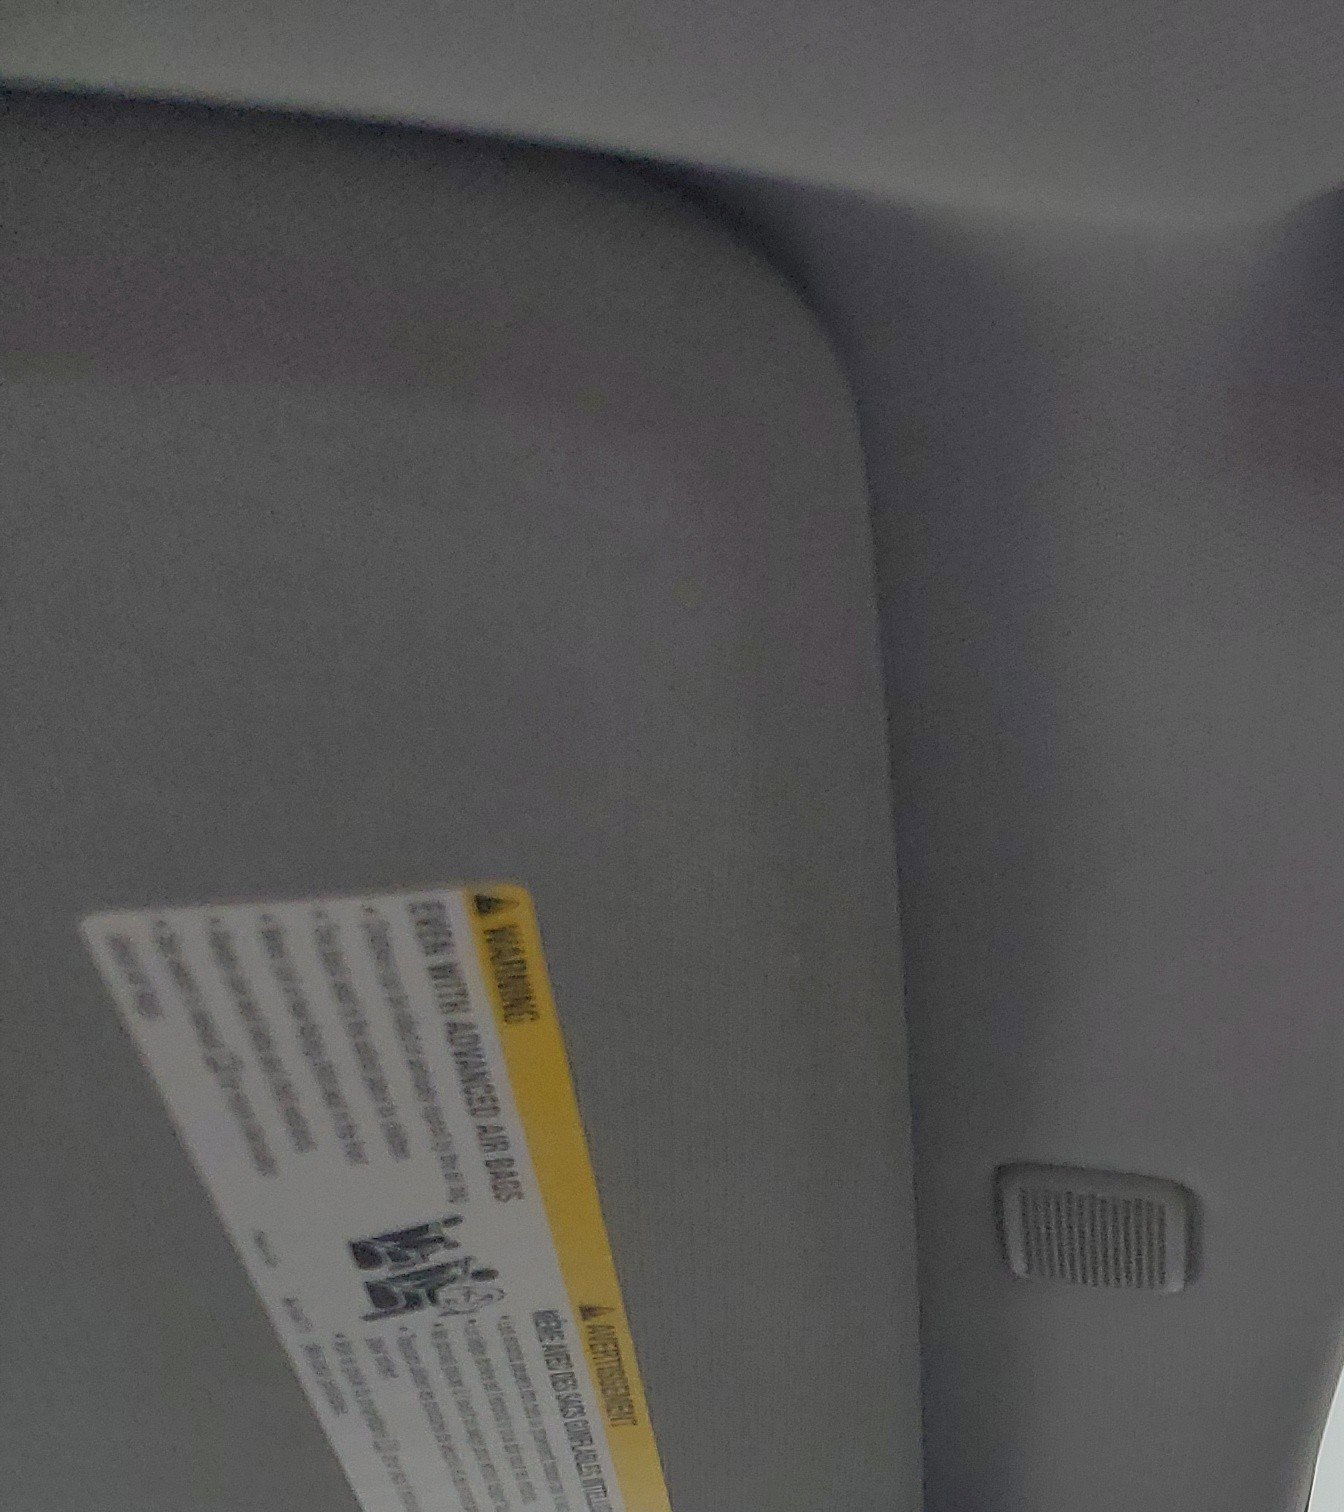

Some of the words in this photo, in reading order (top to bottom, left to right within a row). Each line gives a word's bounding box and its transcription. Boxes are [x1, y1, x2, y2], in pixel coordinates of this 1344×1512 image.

[408, 899, 455, 956] EVEN
[427, 961, 472, 1014] WITH
[483, 922, 540, 1025] WARNING
[445, 1019, 501, 1118] ADVANCED
[476, 1122, 511, 1154] AIR
[485, 1156, 525, 1203] BAGS
[550, 1371, 579, 1394] DES
[586, 1322, 638, 1428] AVERTISSEMENT
[556, 1392, 586, 1420] SACS
